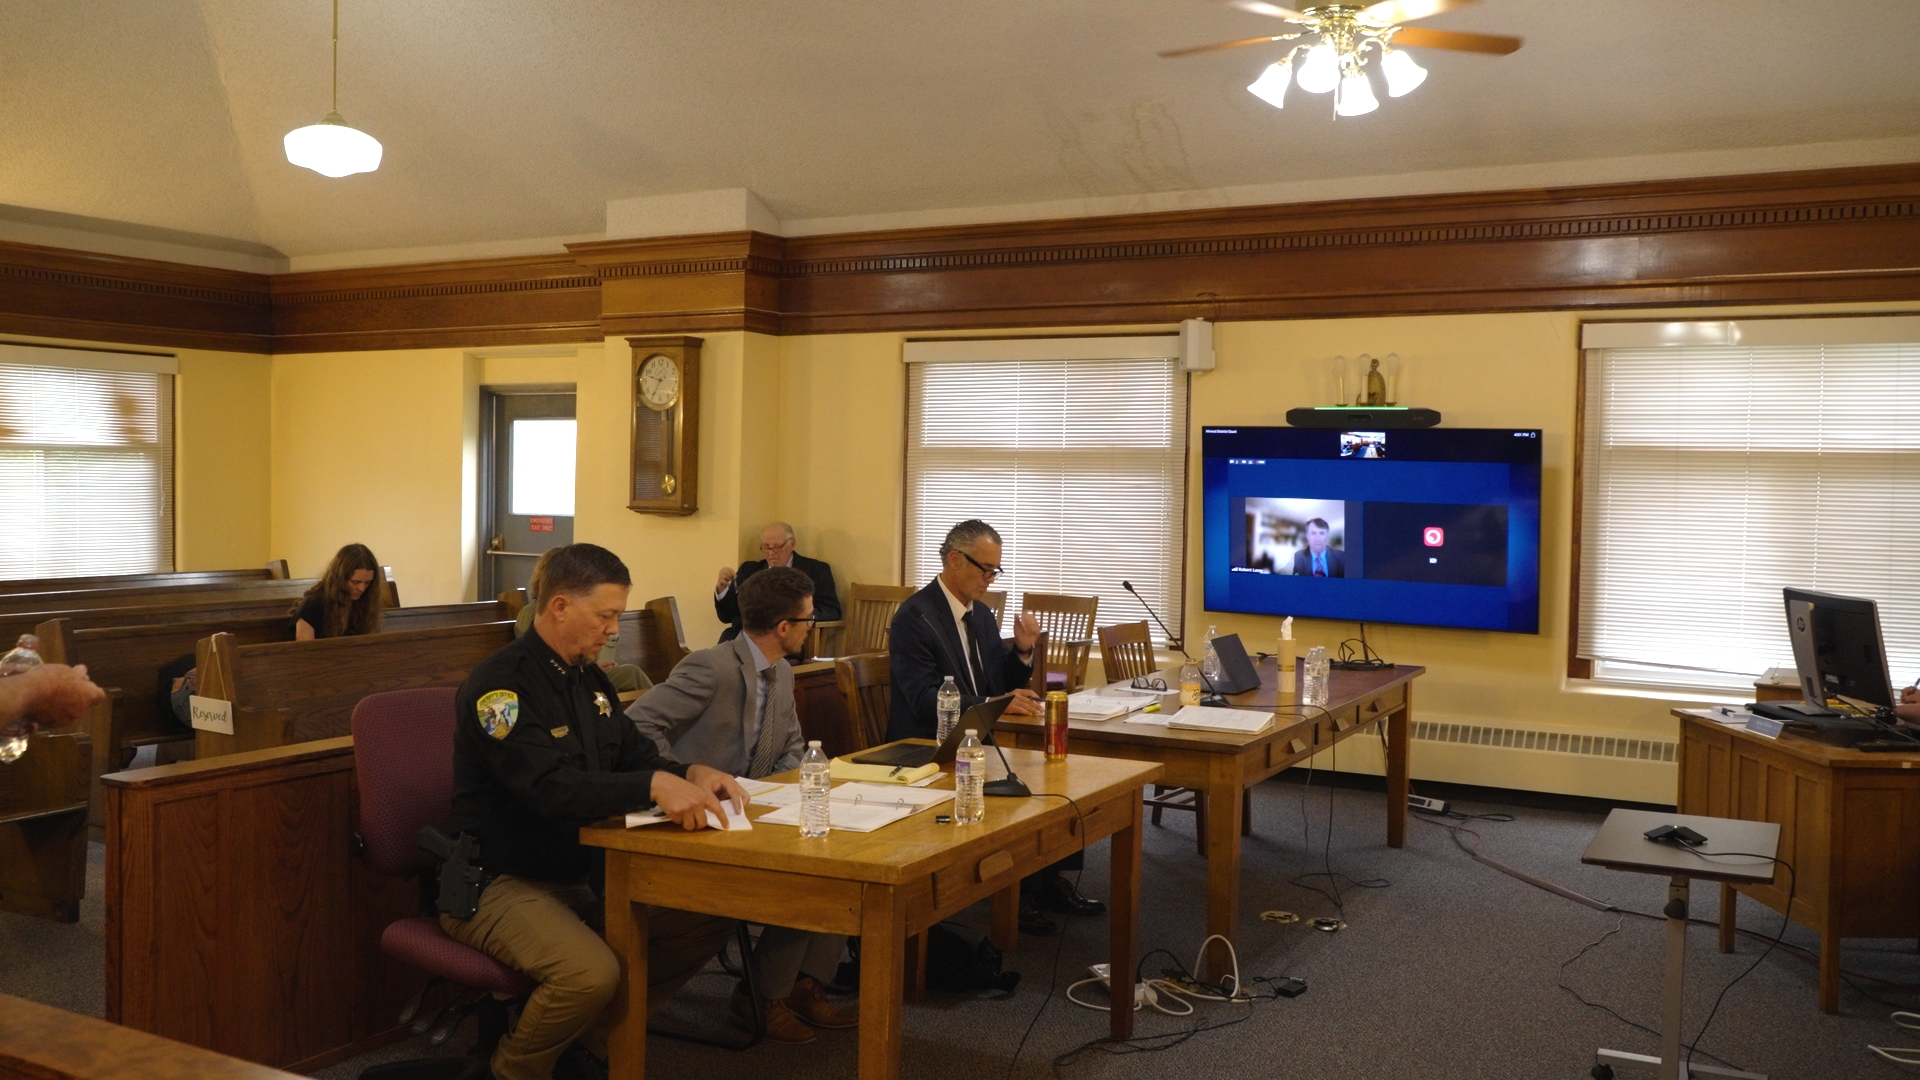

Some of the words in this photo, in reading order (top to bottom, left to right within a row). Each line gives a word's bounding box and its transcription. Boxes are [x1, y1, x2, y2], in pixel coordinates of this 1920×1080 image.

[479, 692, 499, 707] SHERIFF'S
[499, 691, 515, 700] OFFICE
[192, 706, 228, 723] Reserved
